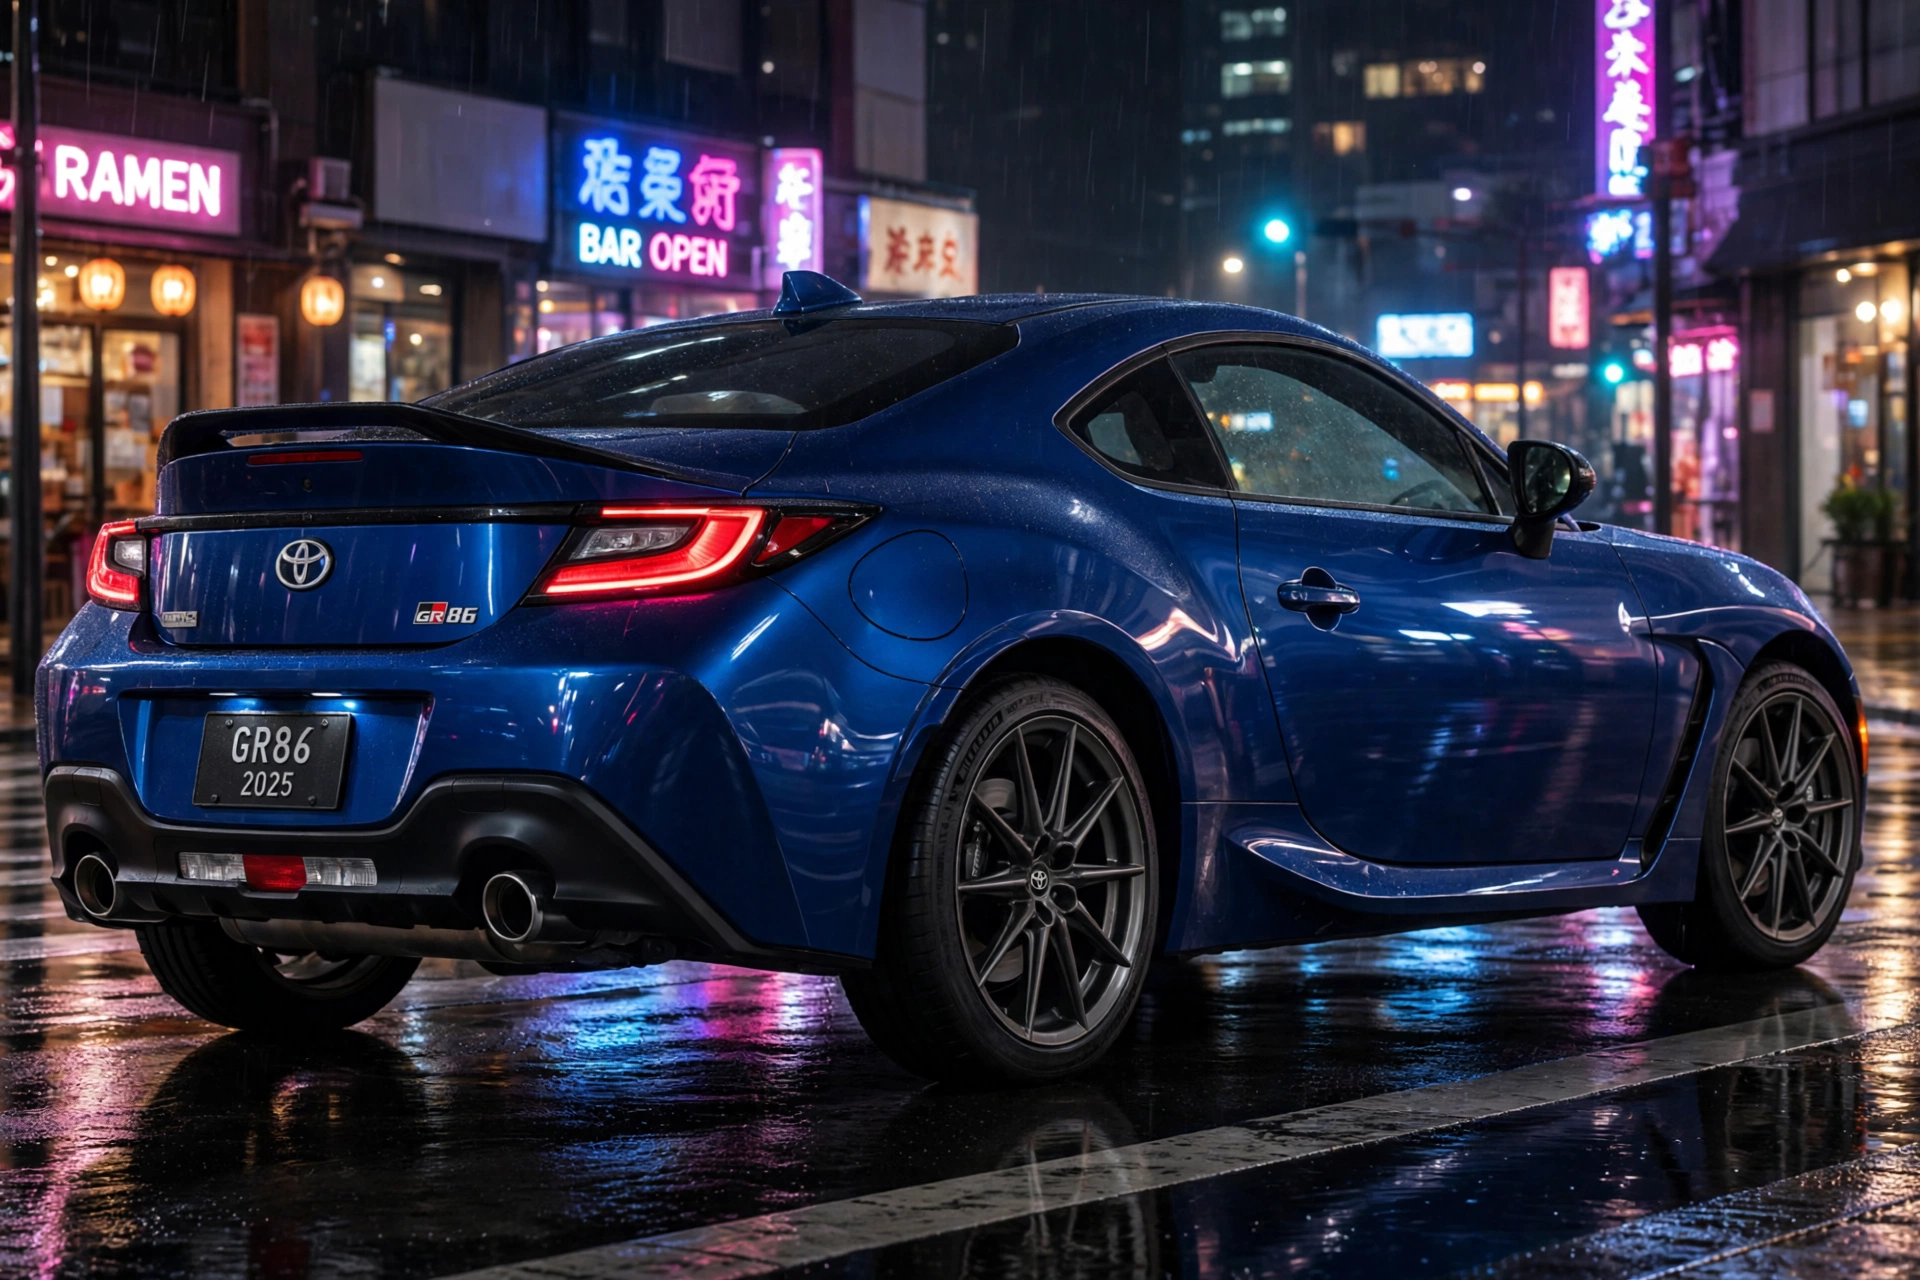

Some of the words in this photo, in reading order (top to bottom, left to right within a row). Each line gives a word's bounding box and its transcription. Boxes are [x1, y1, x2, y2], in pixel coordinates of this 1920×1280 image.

[55, 144, 222, 217] RAMEN
[579, 222, 642, 269] BAR
[649, 231, 728, 278] OPEN
[231, 726, 315, 764] GR86
[240, 771, 295, 797] 2025
